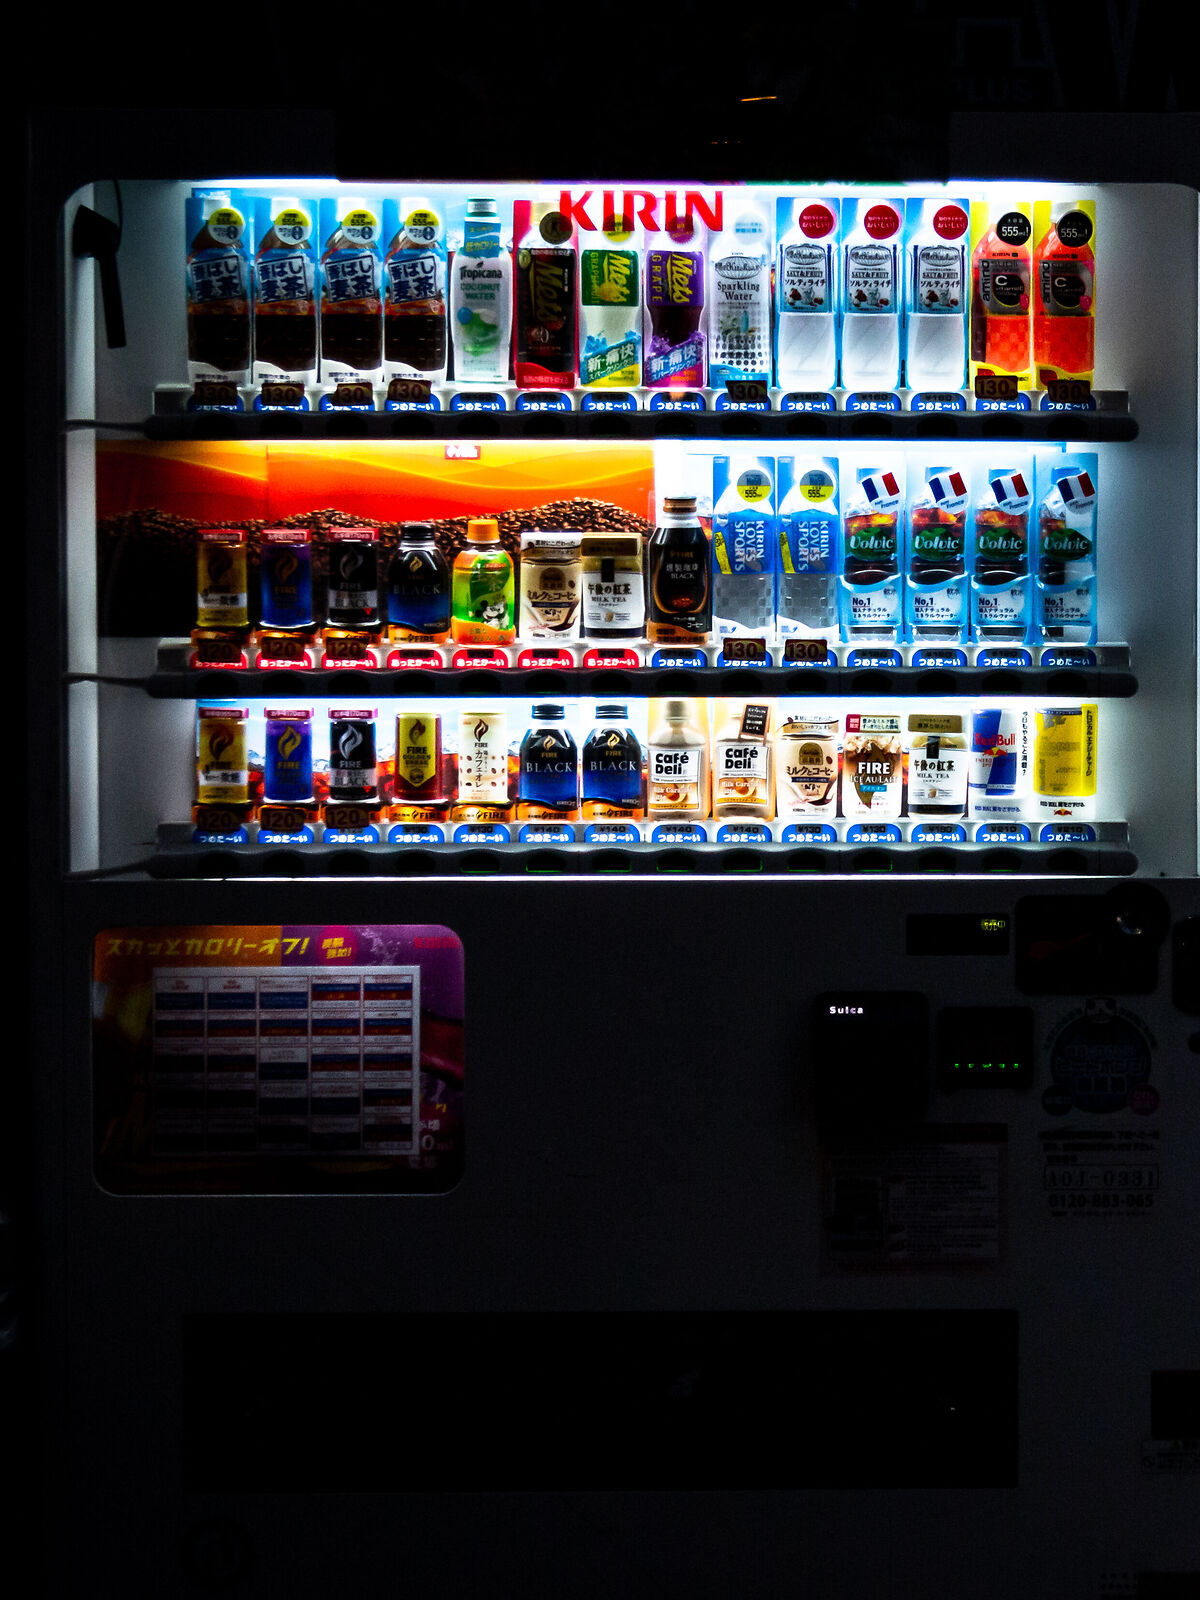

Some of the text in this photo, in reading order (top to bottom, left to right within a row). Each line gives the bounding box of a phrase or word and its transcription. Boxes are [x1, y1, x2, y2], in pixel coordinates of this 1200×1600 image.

[560, 190, 723, 232] KIRIN
[193, 259, 238, 281] 香ばし
[259, 259, 303, 281] 香ばし
[326, 259, 371, 281] 香ばし
[389, 259, 434, 281] 香ばし
[459, 266, 502, 281] Tropicana
[608, 252, 633, 304] Mets
[651, 254, 663, 303] GRAPE
[671, 252, 696, 304] Mets
[981, 260, 991, 302] amino
[995, 274, 1008, 286] C
[1055, 276, 1068, 287] C
[195, 276, 241, 300] 麦茶
[261, 275, 306, 301] 麦茶
[329, 275, 373, 300] 麦茶
[392, 275, 437, 300] 麦茶
[460, 283, 500, 292] COCONUT
[717, 281, 760, 293] Sparkling
[465, 292, 496, 301] WATER
[724, 290, 753, 301] Water
[977, 380, 1011, 396] 130
[734, 520, 745, 572] SPORTS
[744, 520, 756, 562] LOVES
[756, 520, 765, 559] KIRIN
[798, 520, 809, 571] SPORTS
[808, 520, 820, 562] LOVES
[819, 520, 829, 559] KIRIN
[850, 534, 894, 550] Volvic
[914, 534, 960, 550] Volvic
[979, 534, 1023, 550] Volvic
[1044, 534, 1088, 550] Volvic
[393, 584, 441, 595] BLACK
[527, 590, 577, 602] ミルクとコーヒー
[588, 583, 632, 595] 午後の紅茶
[726, 643, 758, 658] 130
[786, 642, 821, 658] 130
[975, 733, 1016, 746] Red Bull
[407, 746, 429, 755] FIRE
[725, 747, 758, 759] Café
[339, 760, 362, 768] FIRE
[655, 752, 689, 764] Café
[725, 758, 751, 769] Deli
[914, 759, 955, 771] 午後の紅茶
[277, 761, 300, 770] FIRE
[474, 750, 482, 788] カフェオレ
[525, 761, 573, 773] BLACK
[590, 760, 637, 772] BLACK
[655, 763, 682, 775] Deli
[786, 765, 834, 776] ミルクとコーヒー
[858, 761, 890, 774] FIRE
[334, 777, 368, 786] BLACK
[328, 810, 360, 825] 120
[419, 811, 442, 820] FIRE
[483, 811, 506, 820] FIRE
[549, 812, 568, 820] FIRE
[614, 810, 634, 818] FIRE
[664, 824, 692, 833] ¥140
[829, 1006, 864, 1015] Suica
